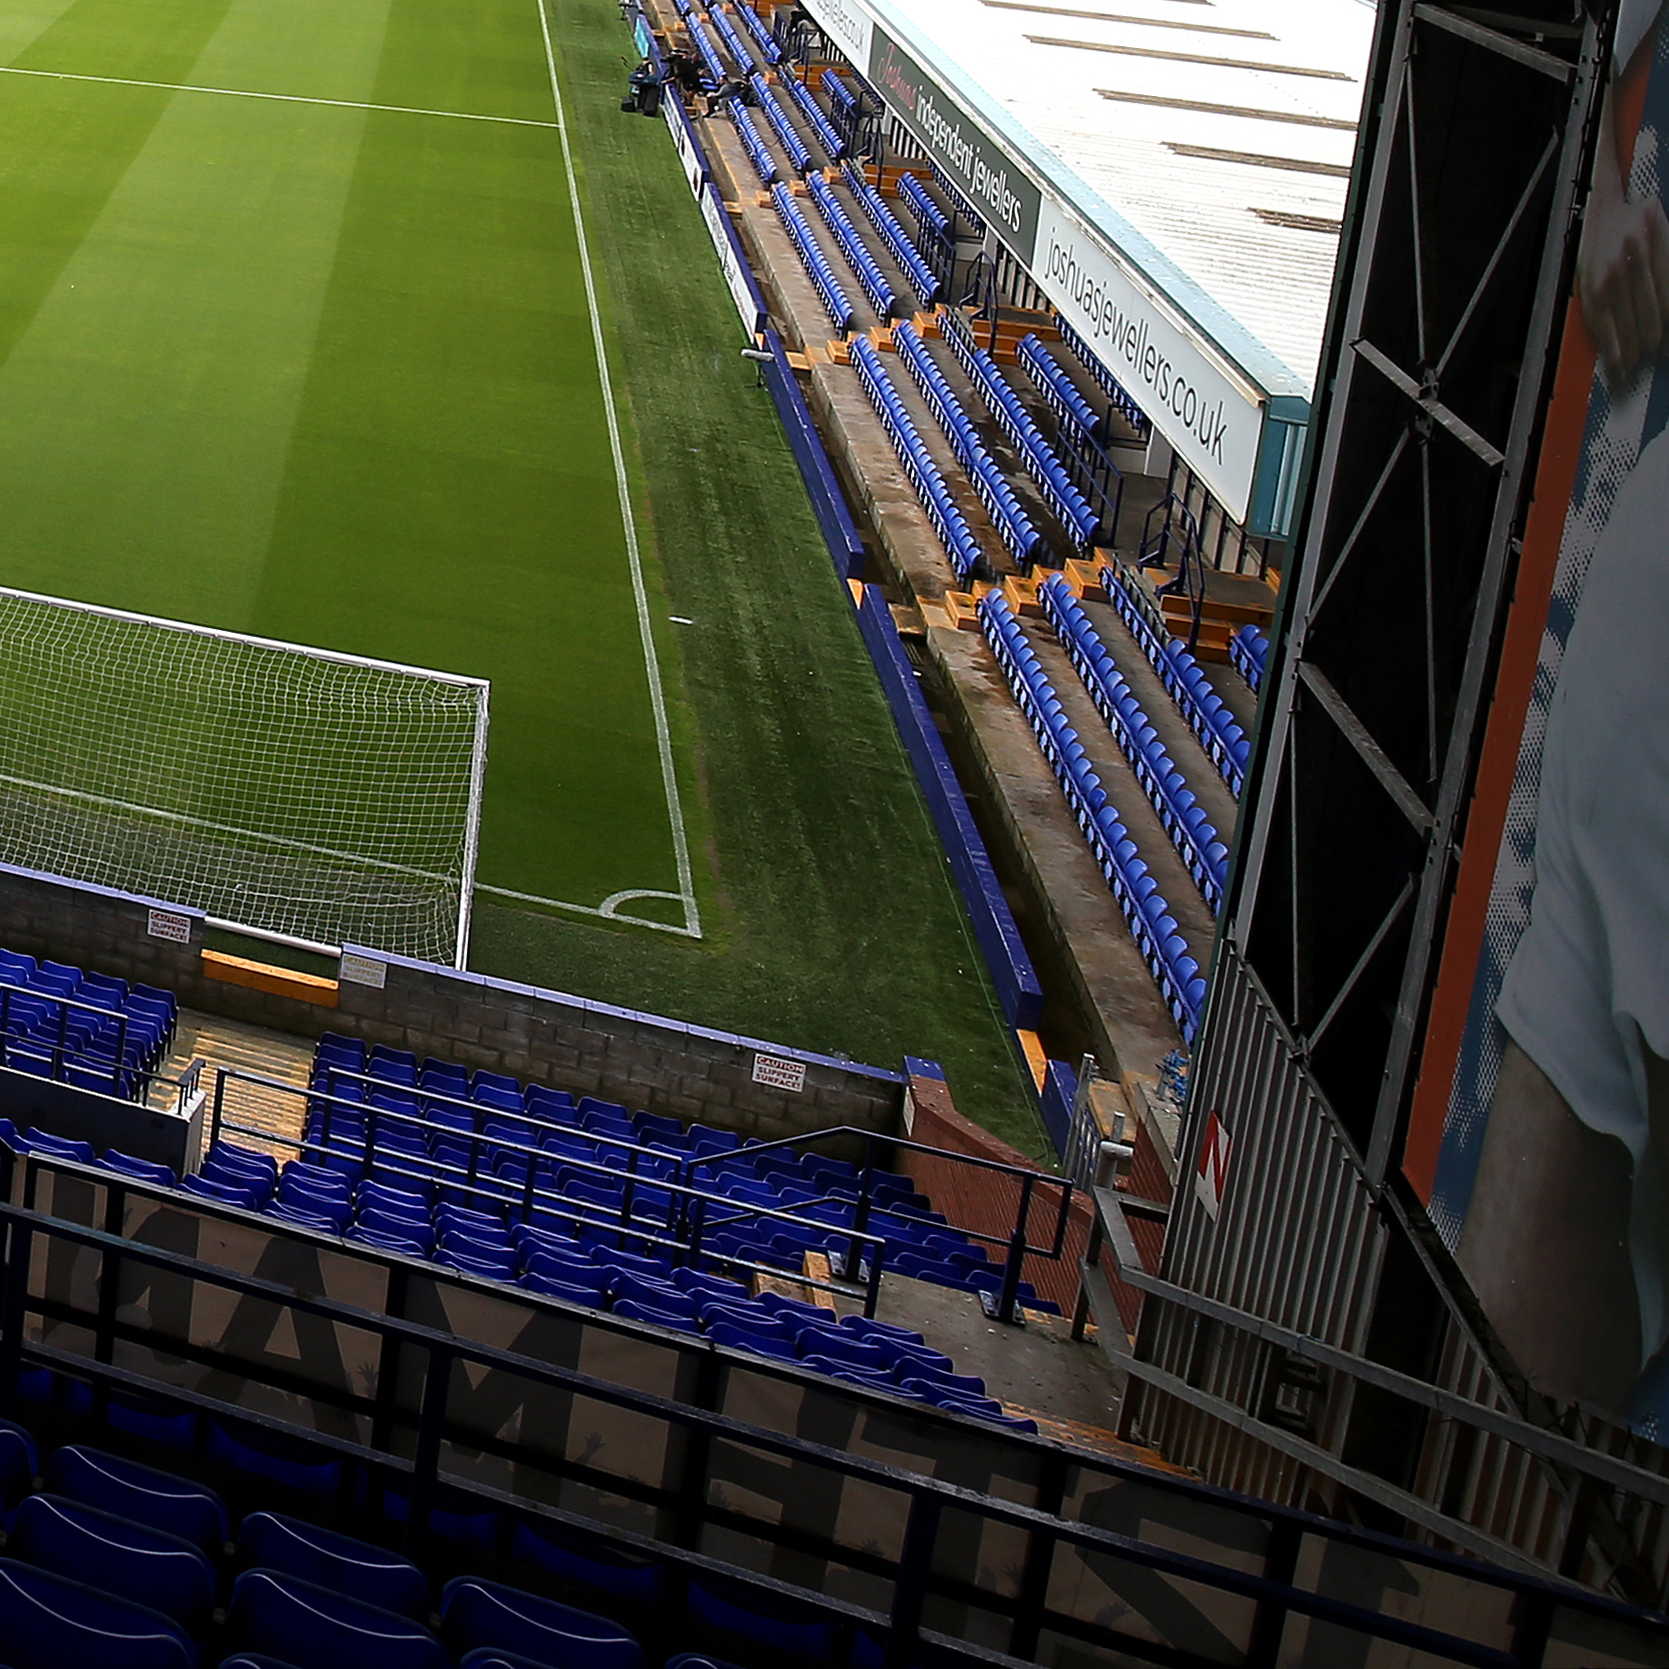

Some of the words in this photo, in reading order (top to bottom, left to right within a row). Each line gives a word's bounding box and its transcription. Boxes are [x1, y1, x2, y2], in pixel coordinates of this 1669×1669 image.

[916, 85, 974, 180] independent
[969, 146, 1023, 233] jewellers
[1045, 226, 1227, 466] joshuasjewellers.co.uk
[758, 1056, 803, 1073] CAUTION
[758, 1066, 801, 1081] SLIPPERY
